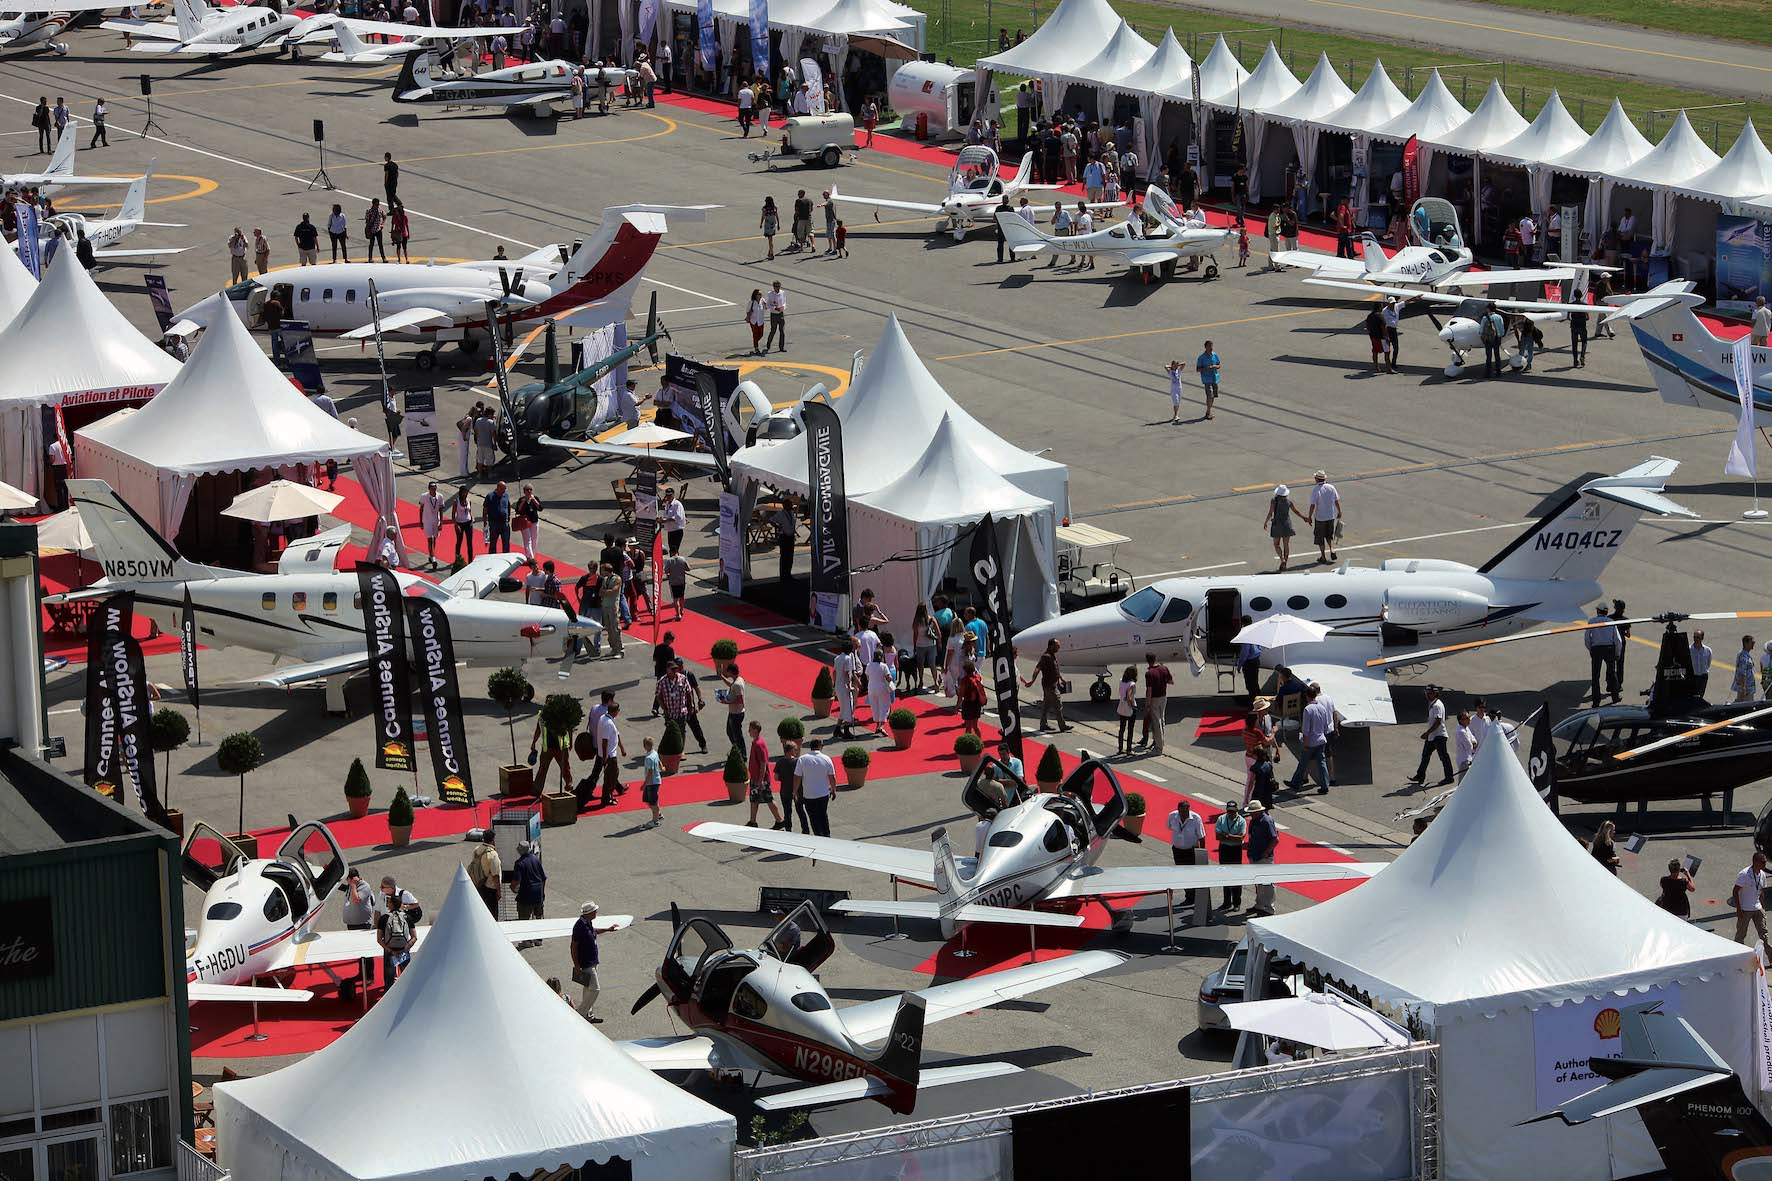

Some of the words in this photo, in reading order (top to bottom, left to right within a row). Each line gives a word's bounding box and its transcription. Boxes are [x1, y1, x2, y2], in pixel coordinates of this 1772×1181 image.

[433, 89, 477, 100] F-GZJC
[61, 391, 107, 406] Aviation
[108, 389, 120, 400] et
[121, 386, 155, 399] Pilote
[1535, 530, 1623, 550] N404CZ
[105, 559, 174, 577] N850VM
[194, 943, 246, 981] F-HGDU
[1556, 1072, 1568, 1083] of
[1687, 1103, 1732, 1114] PHENOM
